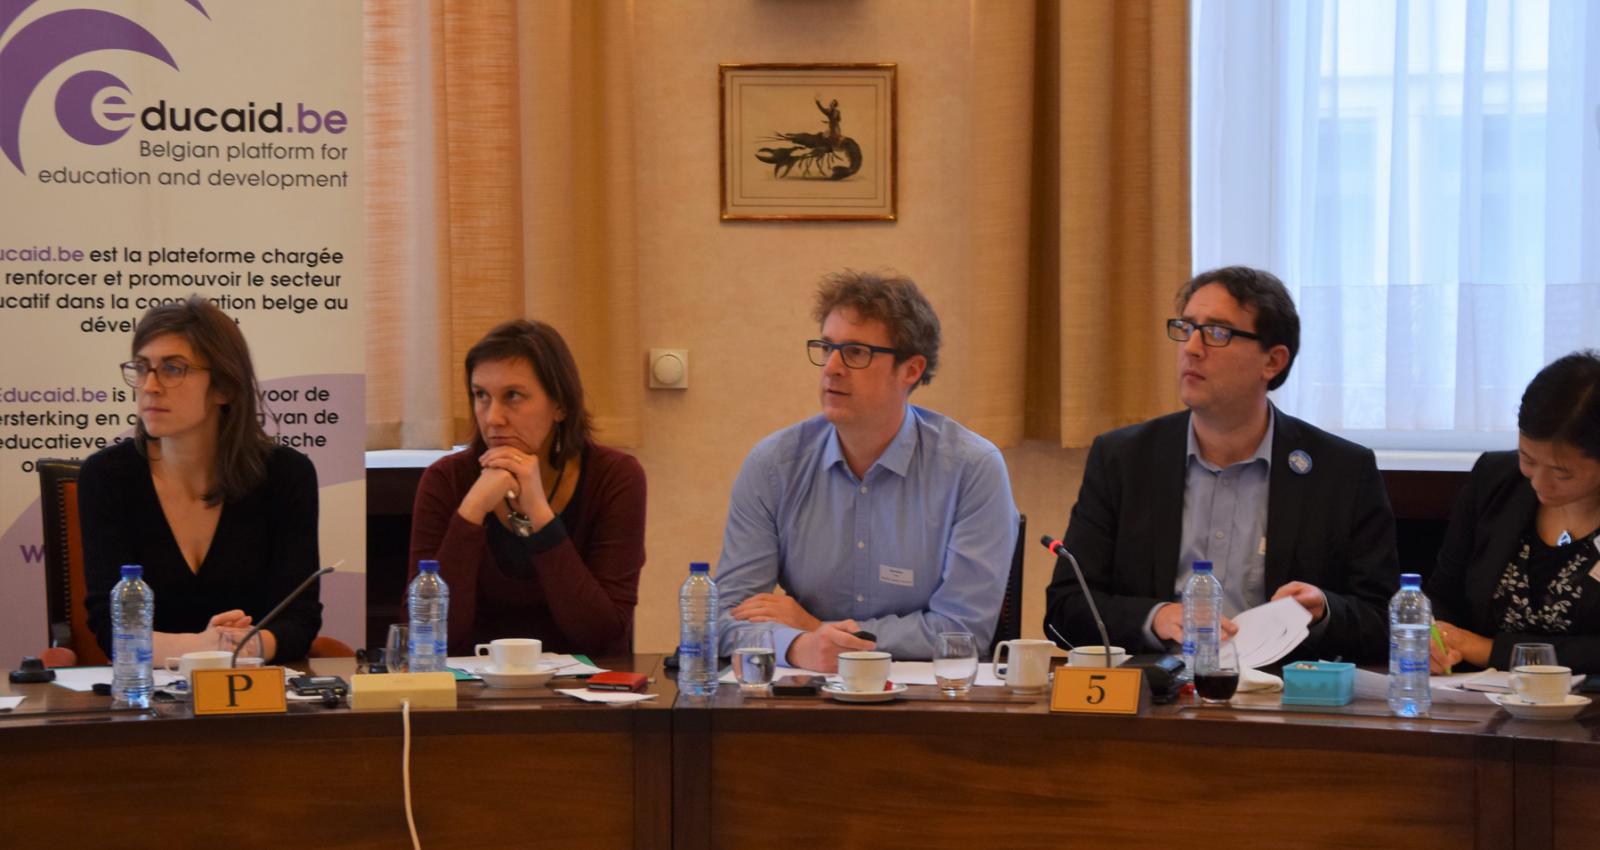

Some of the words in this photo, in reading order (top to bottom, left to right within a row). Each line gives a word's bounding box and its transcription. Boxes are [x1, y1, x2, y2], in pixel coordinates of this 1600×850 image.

[139, 140, 219, 162] Belgian
[227, 142, 315, 162] platform
[321, 143, 348, 160] for
[38, 166, 151, 185] education
[158, 169, 201, 186] and
[208, 170, 348, 190] development
[89, 246, 118, 262] est
[124, 247, 142, 262] la
[148, 247, 256, 266] plateforme
[261, 247, 344, 267] chargée
[5, 270, 98, 286] renforcer
[103, 270, 122, 286] et
[129, 270, 242, 289] promouvoir
[247, 271, 265, 287] le
[270, 273, 342, 288] secteur
[56, 293, 105, 309] dans
[111, 294, 129, 309] la
[262, 294, 319, 314] belge
[324, 297, 349, 311] au
[0, 386, 108, 403] ducaid.be
[112, 386, 126, 402] is
[304, 386, 330, 402] de
[0, 411, 89, 430] rsterking
[95, 413, 120, 426] en
[272, 412, 308, 425] van
[313, 409, 340, 424] de
[226, 673, 253, 707] P
[1086, 674, 1107, 705] 5
